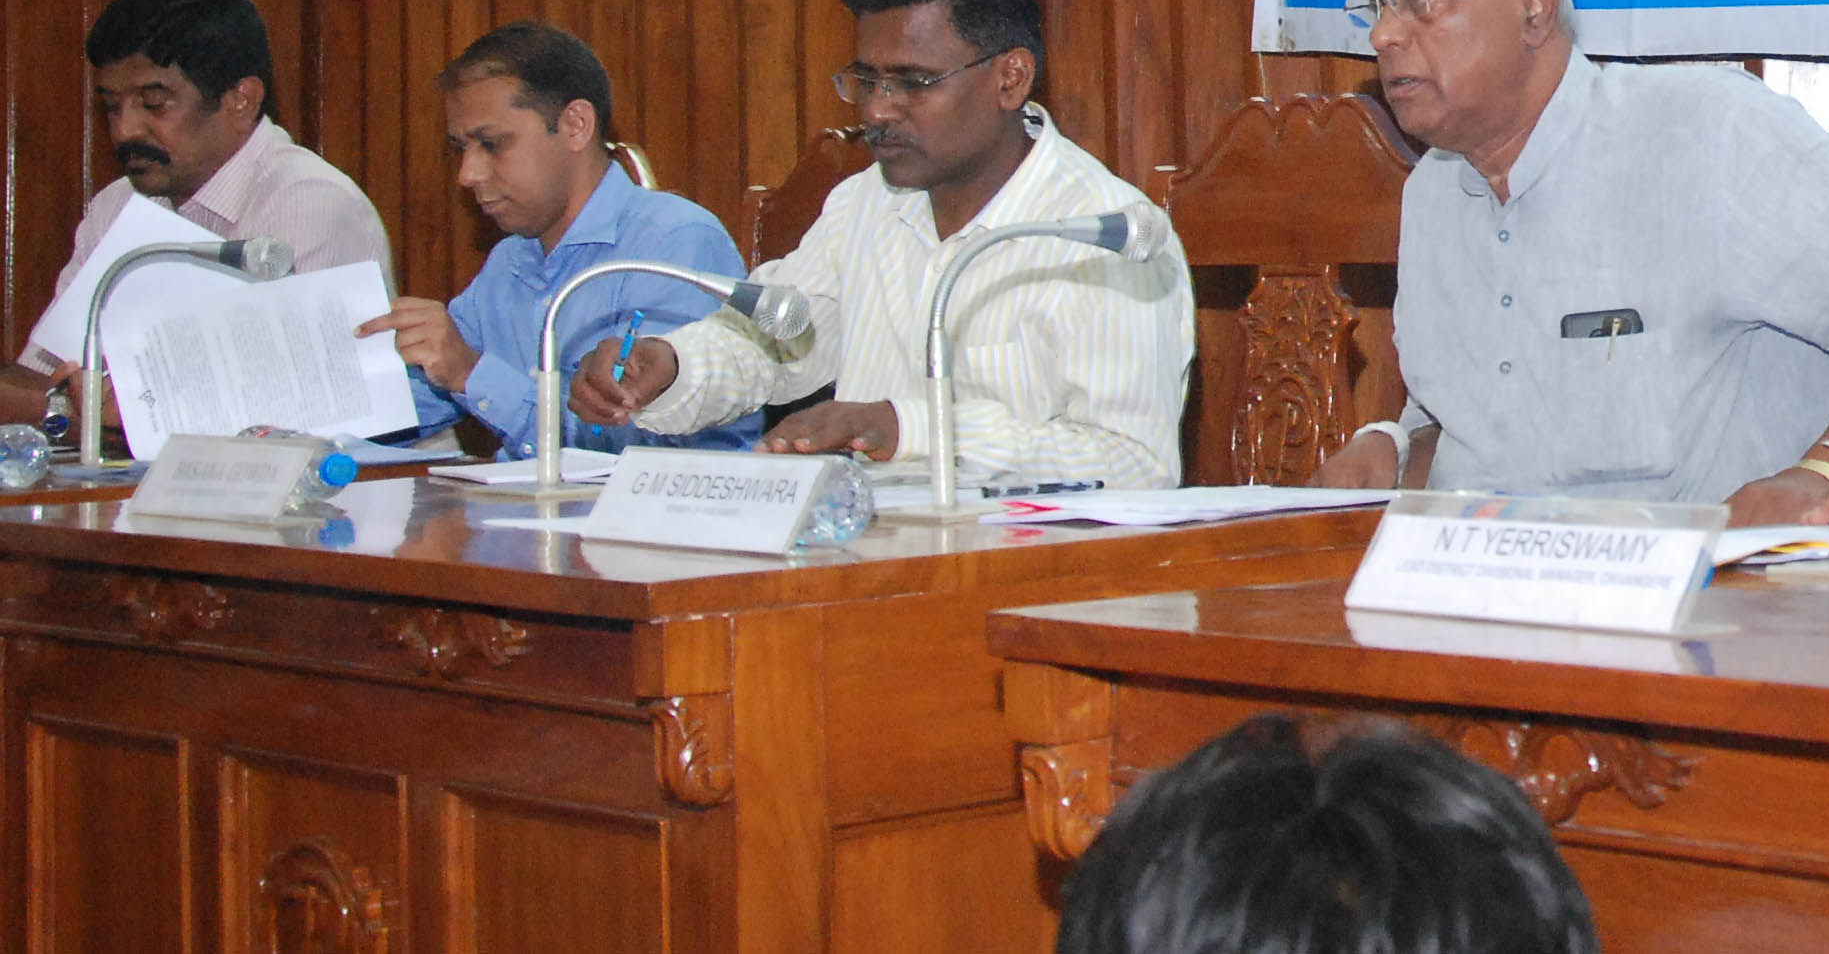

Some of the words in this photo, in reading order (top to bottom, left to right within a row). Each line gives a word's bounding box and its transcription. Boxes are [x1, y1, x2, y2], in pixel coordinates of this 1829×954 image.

[632, 472, 649, 495] G
[651, 473, 668, 495] M
[667, 473, 800, 503] SIDDESHWARA
[1433, 526, 1458, 553] N
[1461, 526, 1480, 554] T
[1483, 527, 1660, 564] YERRISWAMY
